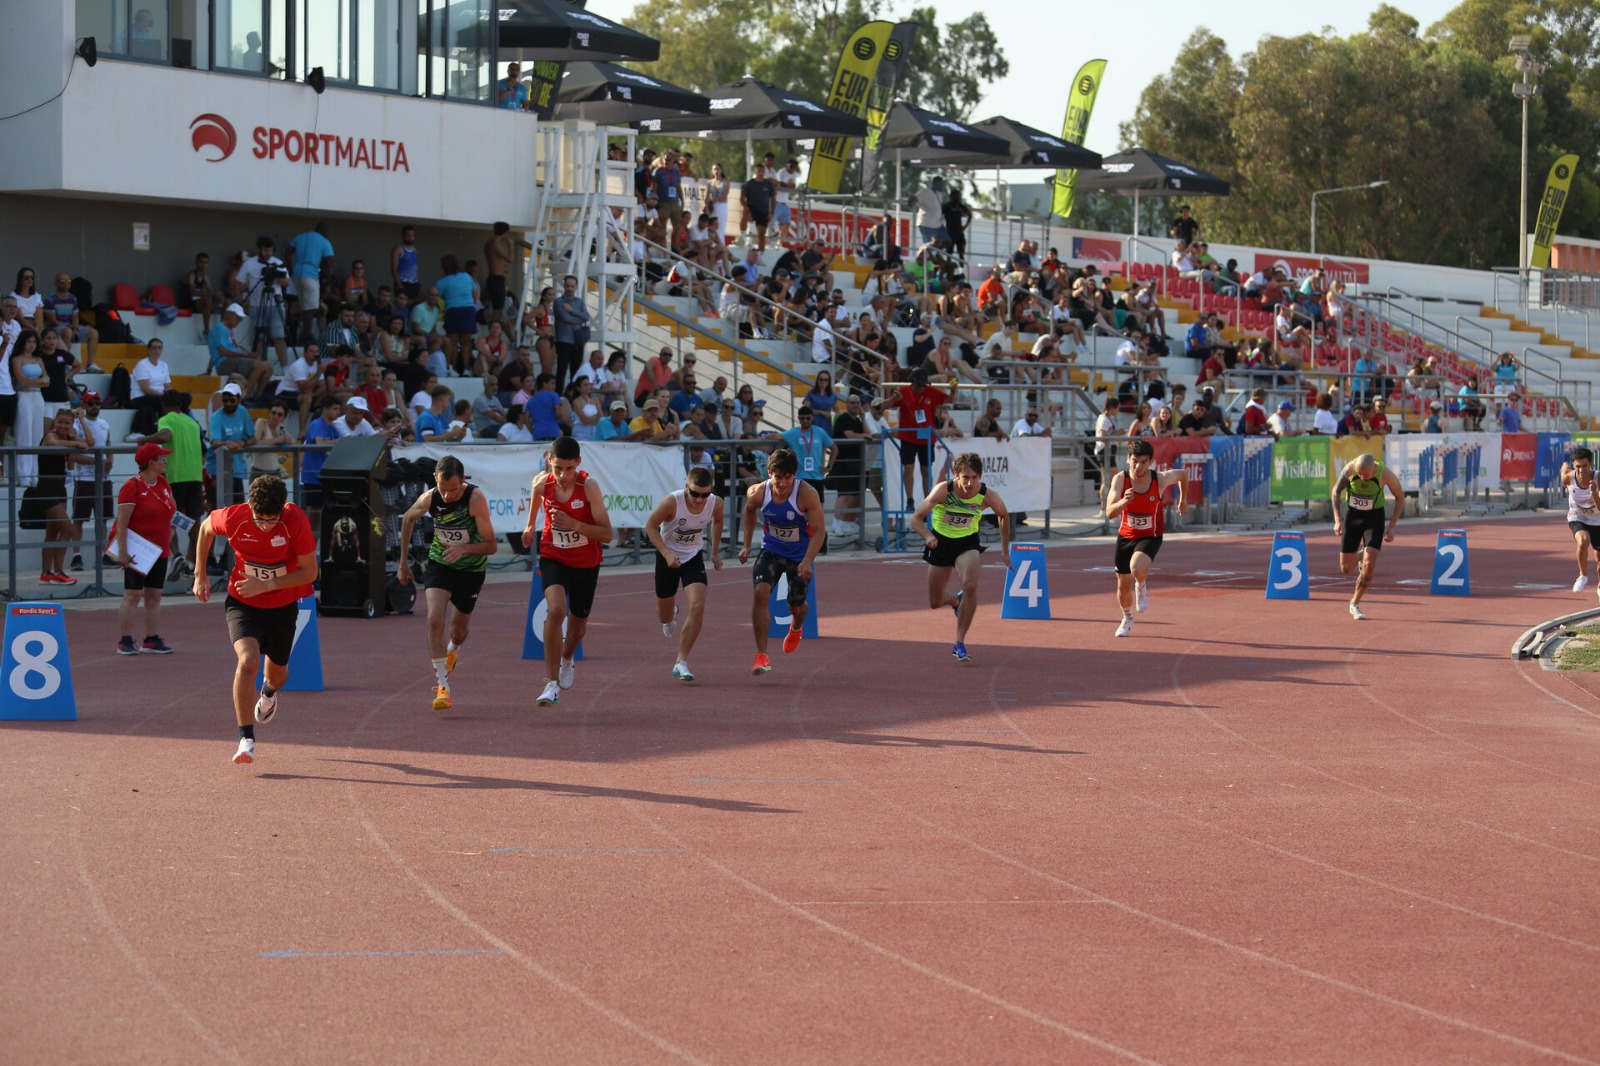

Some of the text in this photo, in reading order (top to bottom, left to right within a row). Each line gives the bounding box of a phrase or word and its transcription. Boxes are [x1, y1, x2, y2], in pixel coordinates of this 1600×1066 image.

[835, 69, 870, 103] EUR
[252, 126, 410, 173] SPORTMALTA
[683, 186, 707, 201] MALT
[1544, 186, 1567, 209] EUR
[1540, 204, 1560, 227] OSP
[788, 220, 874, 250] SPORTMAL
[1296, 266, 1354, 288] SPOMALTA
[1284, 457, 1328, 479] VisitMalta
[489, 499, 515, 516] FOR
[603, 494, 653, 512] OMOTION
[1353, 498, 1369, 507] 303
[948, 516, 968, 525] 334
[1131, 517, 1147, 527] 123
[441, 530, 463, 541] 129
[558, 531, 581, 543] 119
[675, 534, 696, 543] 344
[774, 528, 793, 538] 127
[252, 567, 278, 580] 151
[1273, 547, 1302, 590] 3
[1438, 544, 1465, 586] 2
[1009, 560, 1043, 608] 4
[9, 630, 61, 700] 8
